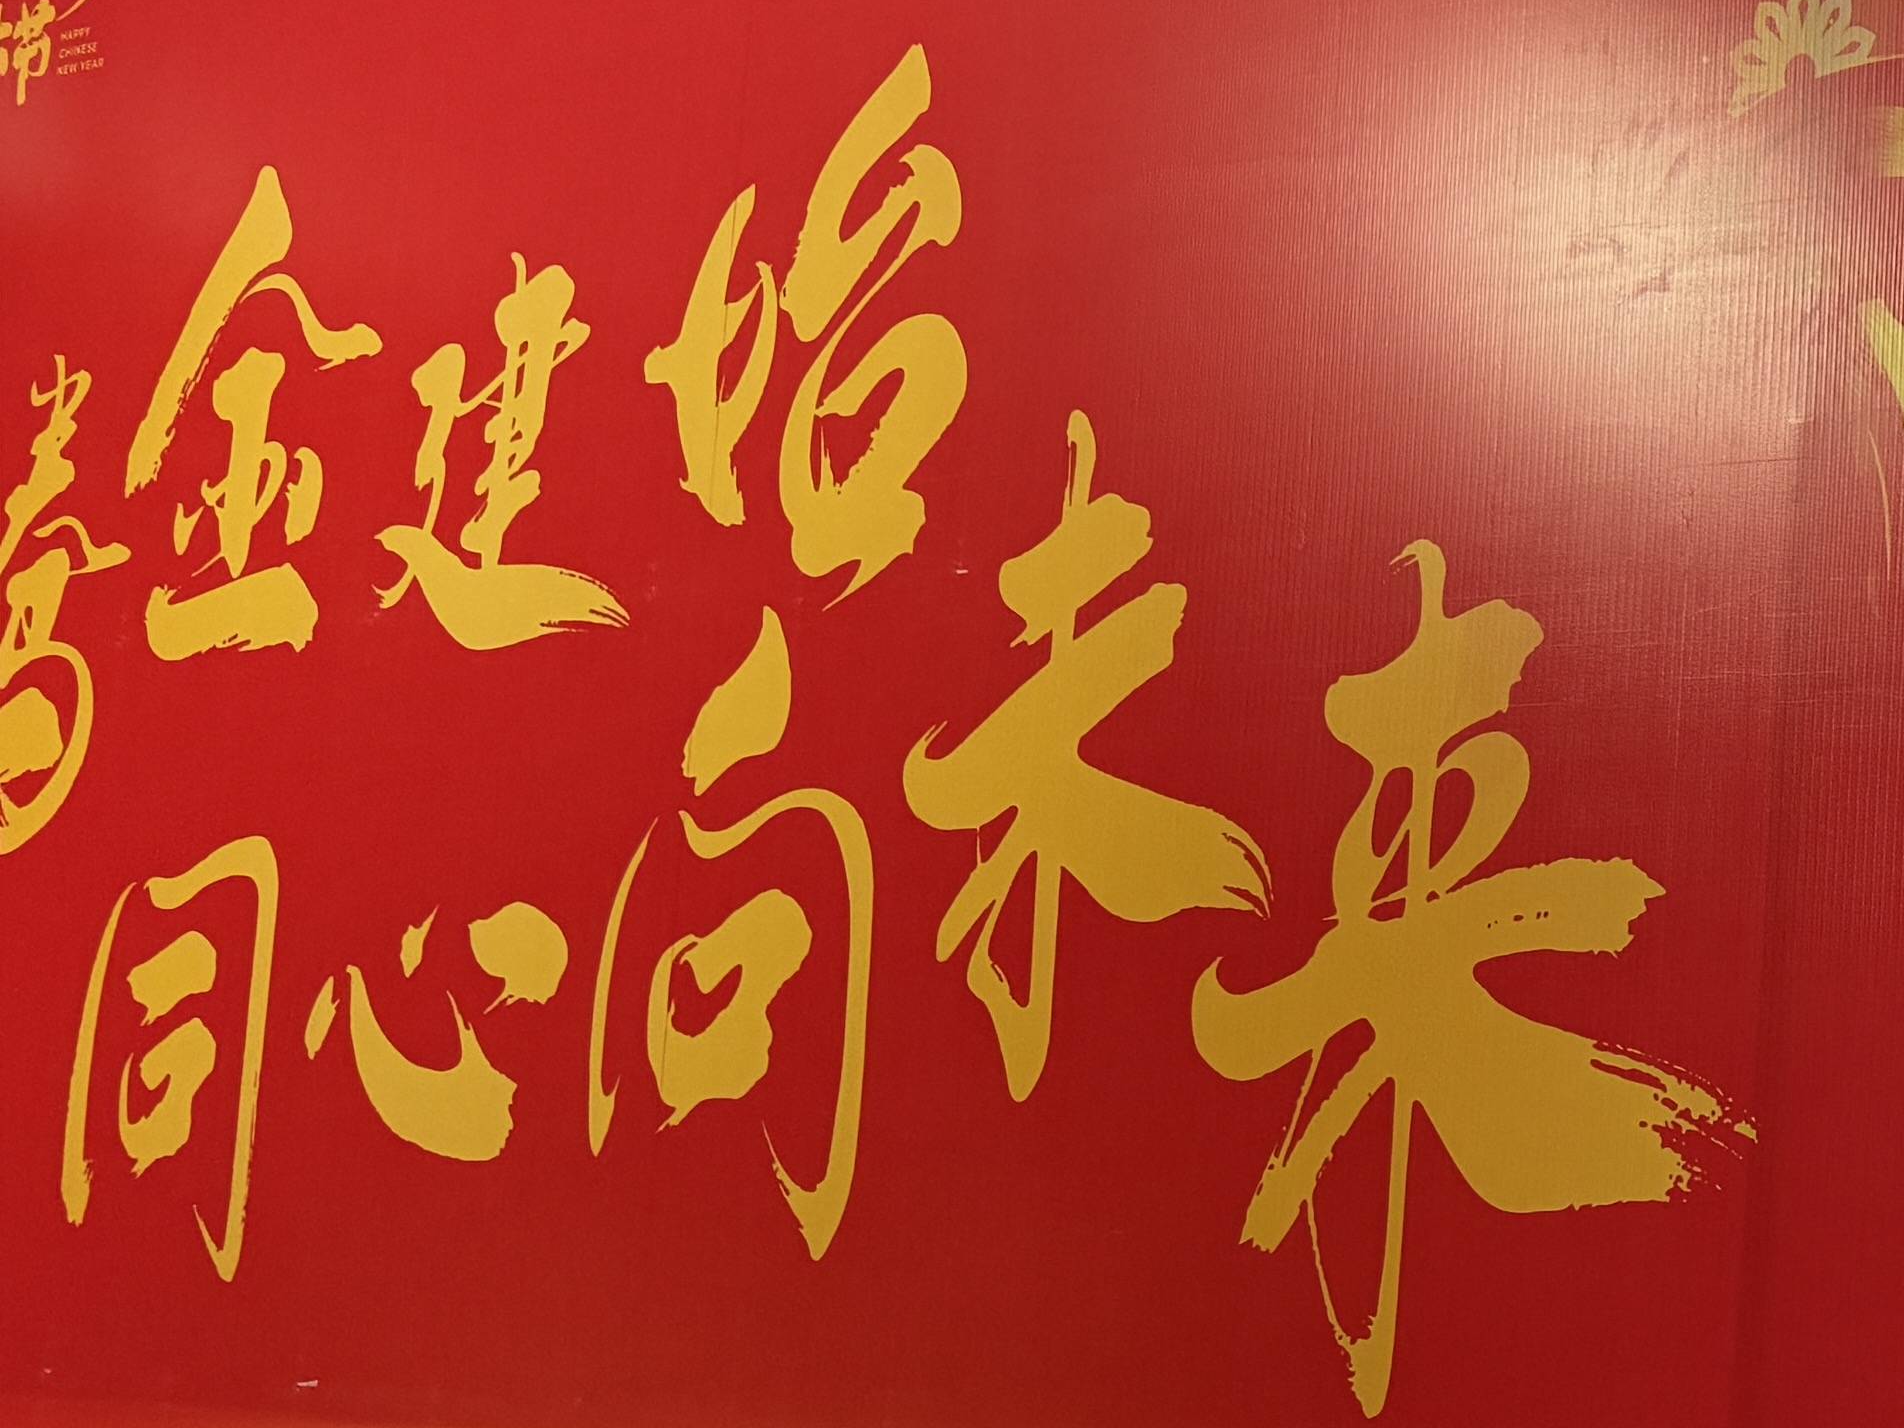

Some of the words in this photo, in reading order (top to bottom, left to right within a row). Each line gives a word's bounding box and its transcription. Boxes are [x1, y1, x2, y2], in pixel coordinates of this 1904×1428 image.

[62, 410, 1758, 1418] 同心向未来
